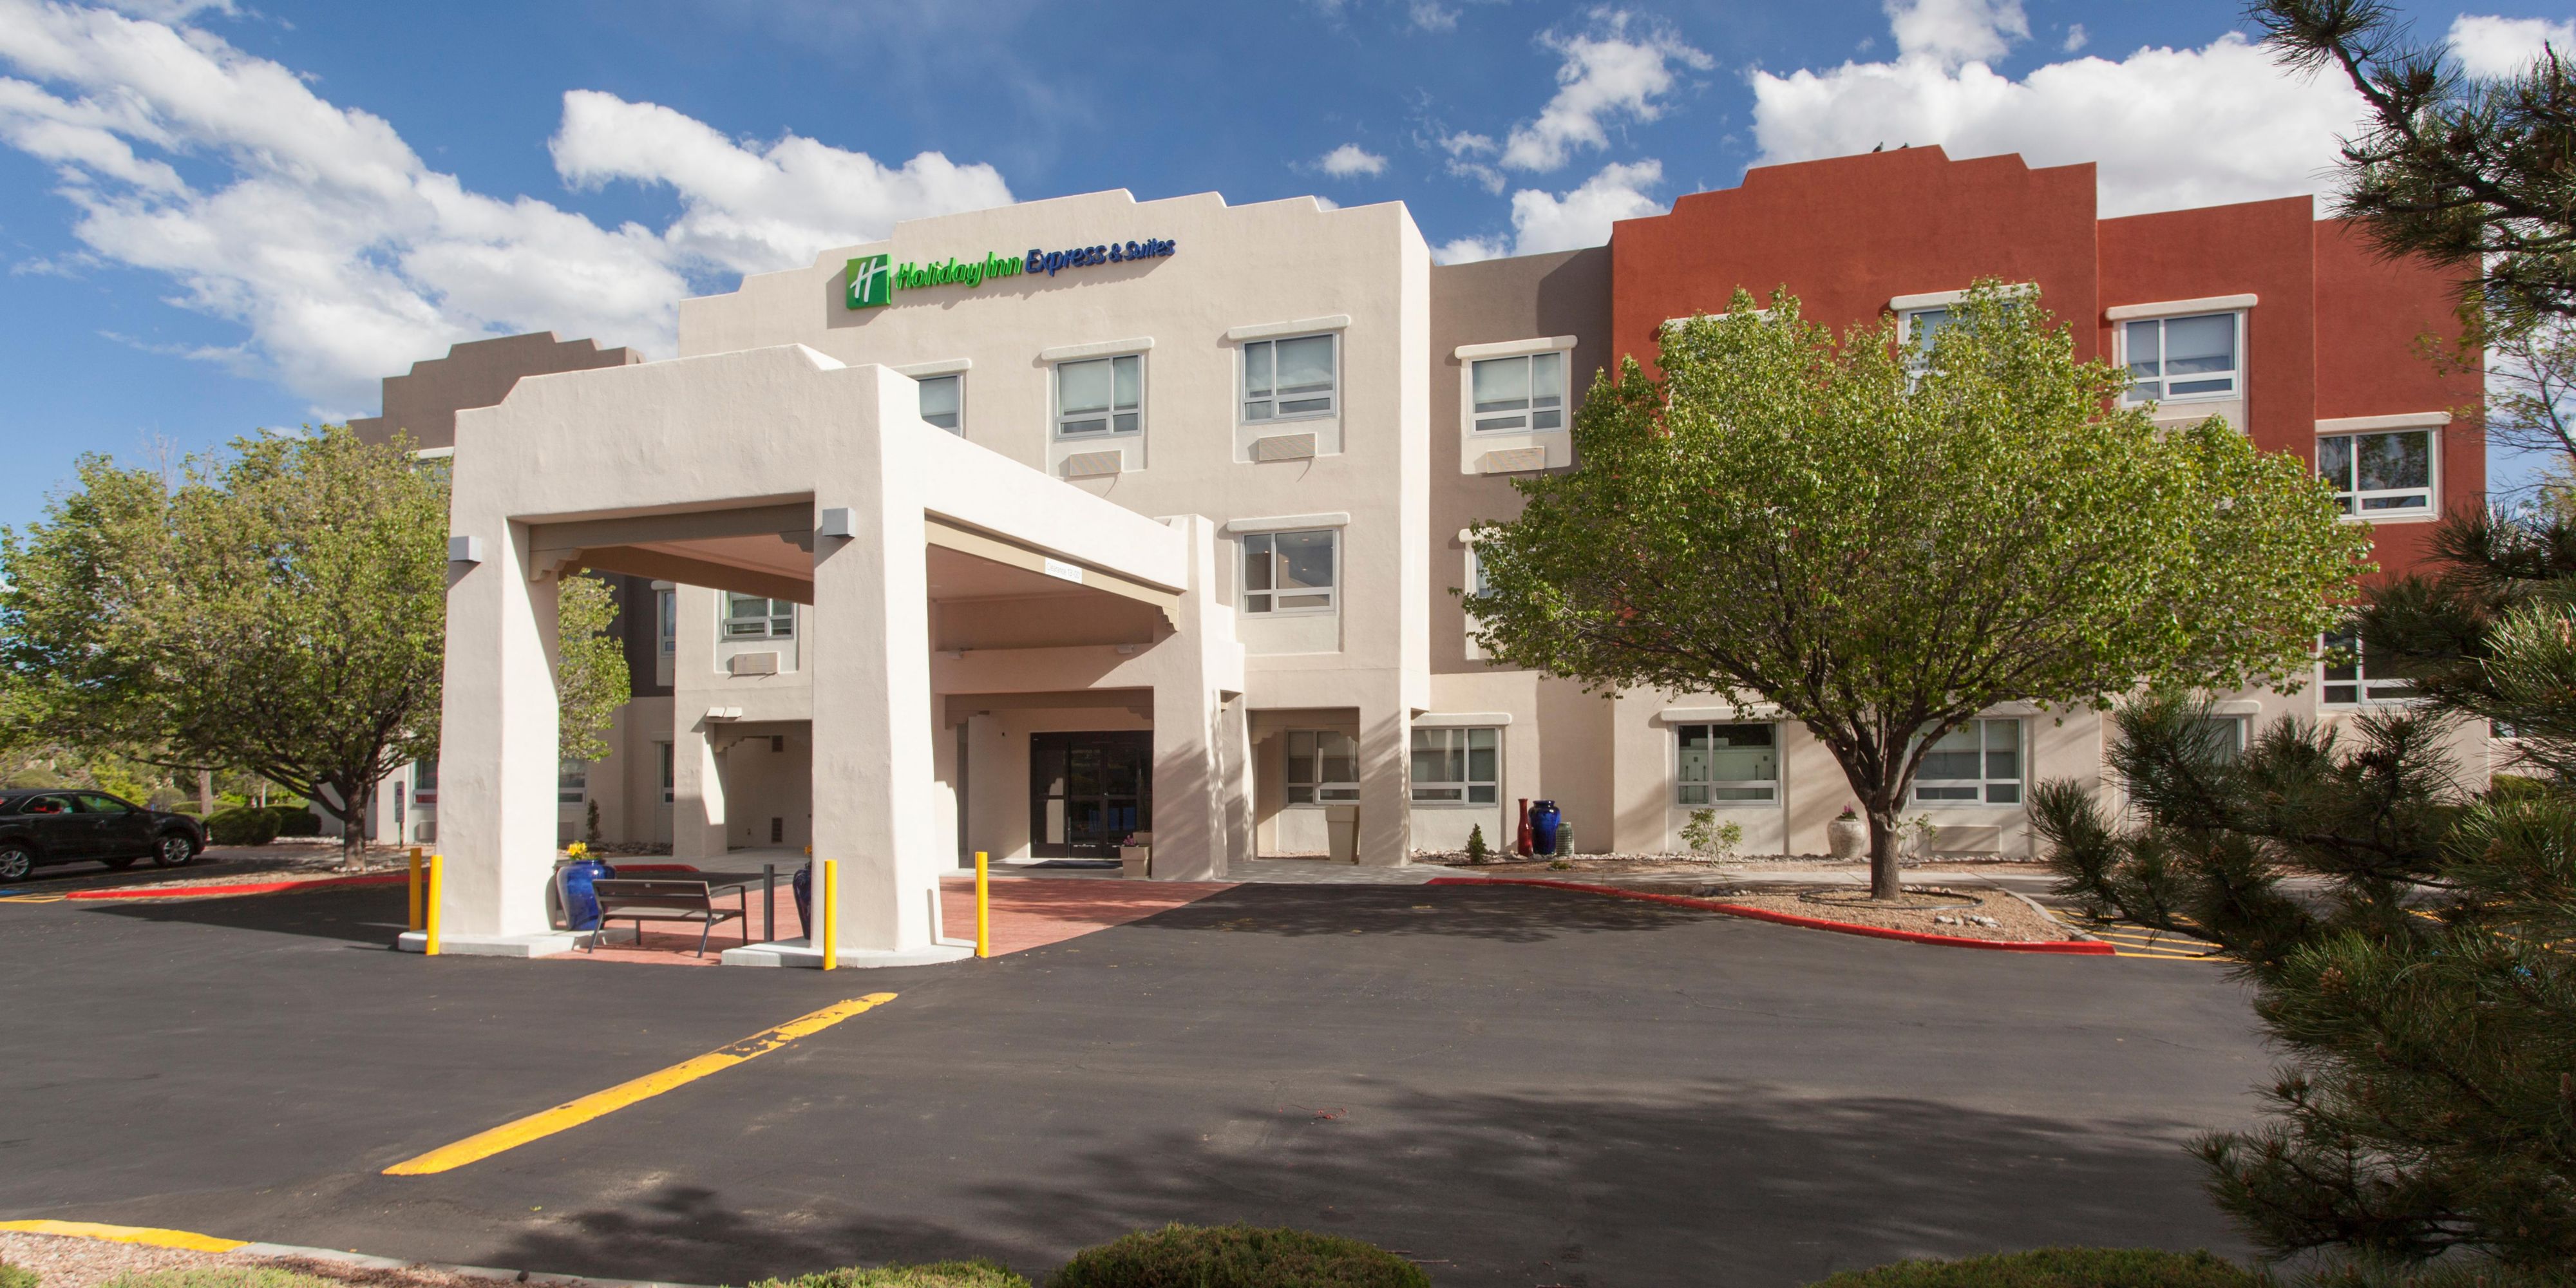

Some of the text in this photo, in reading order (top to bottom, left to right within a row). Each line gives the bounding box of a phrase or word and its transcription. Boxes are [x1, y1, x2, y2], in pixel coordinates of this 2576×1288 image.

[895, 238, 1176, 289] Holiday Inn Express & Suites
